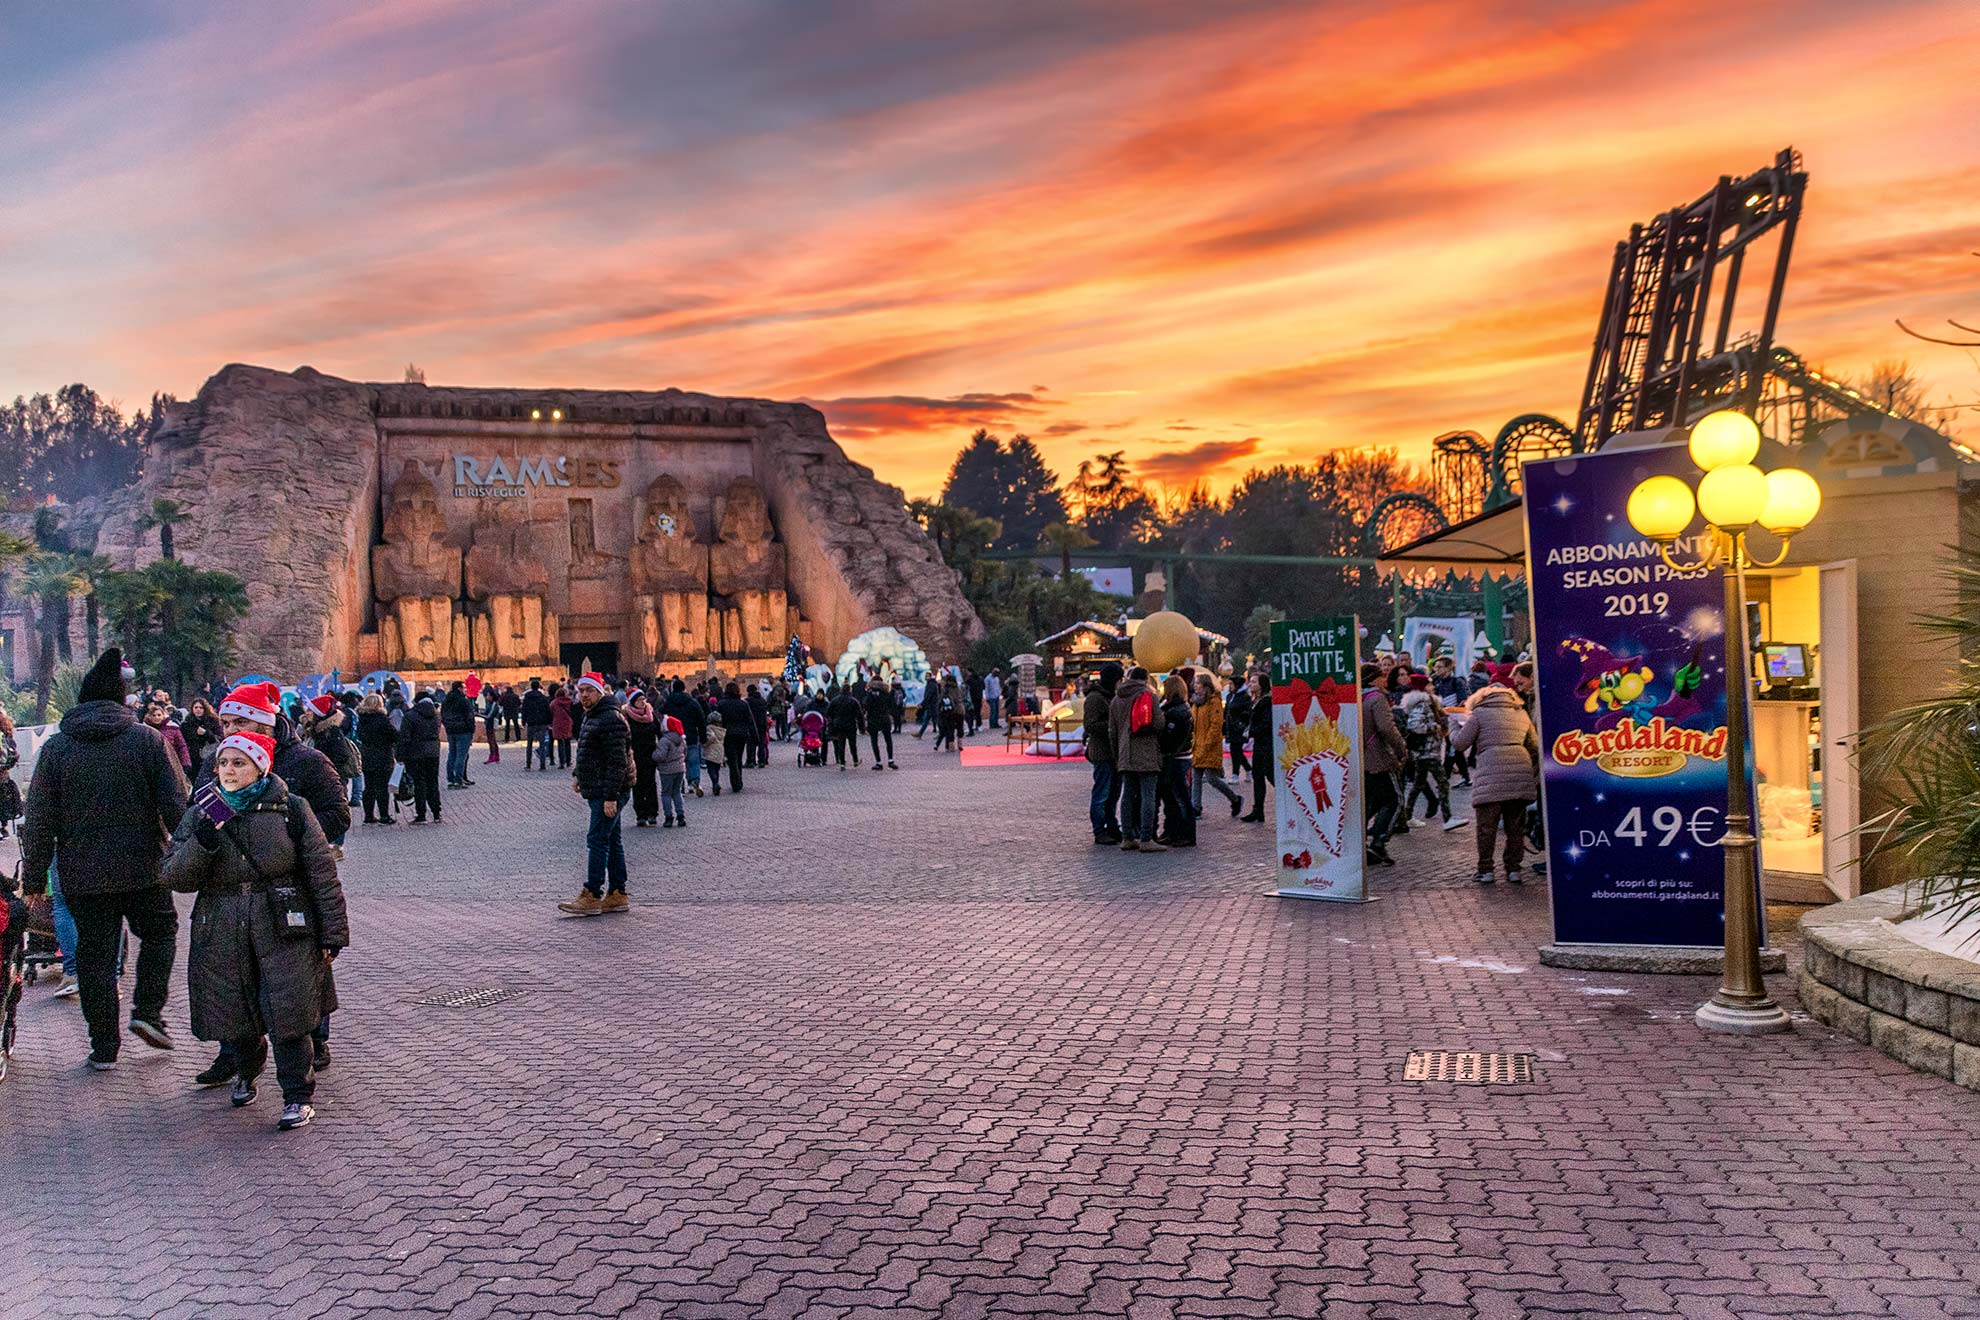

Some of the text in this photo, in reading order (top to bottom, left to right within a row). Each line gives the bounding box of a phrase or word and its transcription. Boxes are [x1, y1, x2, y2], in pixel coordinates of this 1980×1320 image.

[453, 454, 621, 488] RAMSES
[454, 487, 528, 498] IL RISVEGLIO
[1563, 561, 1709, 589] SEASON PASS
[1604, 592, 1670, 617] 2019
[1288, 628, 1335, 653] PATATE
[1281, 650, 1345, 680] FRITTE
[1553, 716, 1728, 765] Gardaland
[1612, 756, 1673, 767] RESORT
[1579, 806, 1721, 847] DA 49€
[1591, 890, 1720, 901] abbonamenti.gardaland.it
[1615, 880, 1645, 888] scopri
[1647, 879, 1657, 887] di
